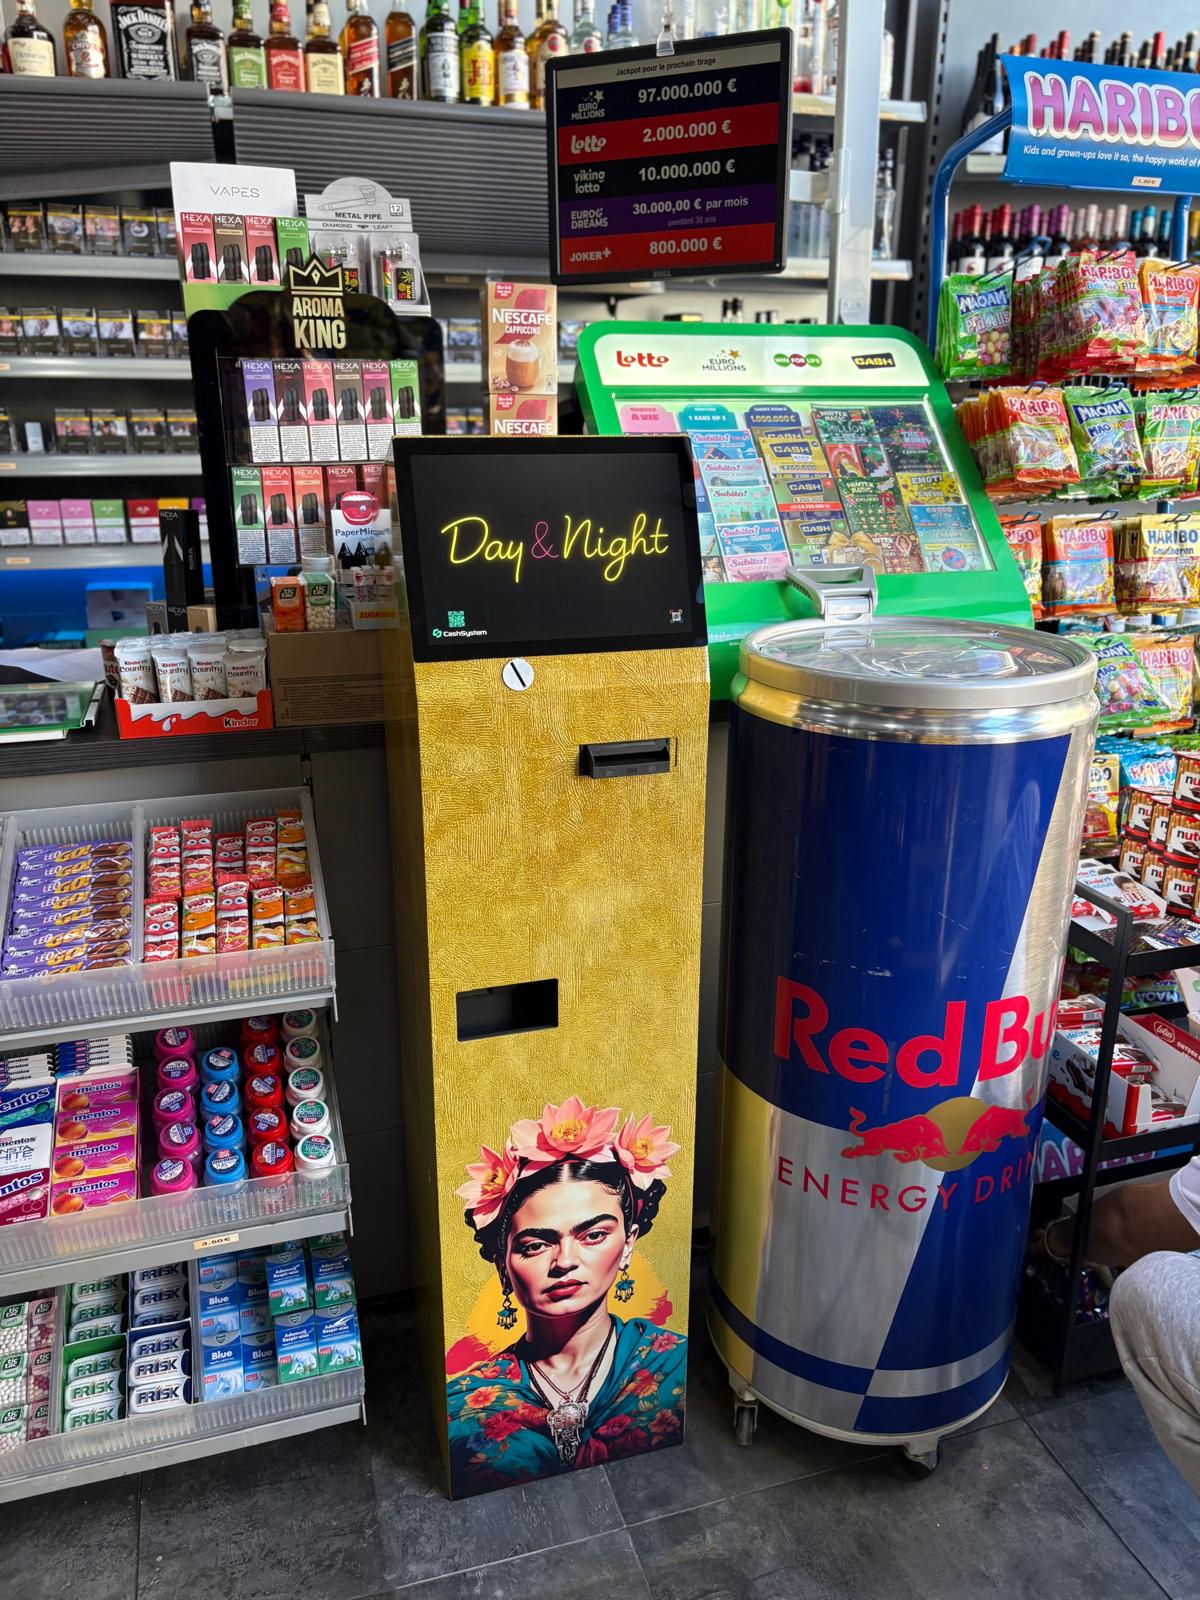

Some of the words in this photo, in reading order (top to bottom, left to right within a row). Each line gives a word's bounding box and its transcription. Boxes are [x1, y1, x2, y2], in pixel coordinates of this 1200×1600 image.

[615, 66, 642, 77] Jackpot
[642, 65, 658, 75] pour
[658, 63, 666, 71] le
[666, 60, 696, 72] prochain
[696, 57, 716, 68] tirage
[638, 80, 722, 104] 97.000.000
[727, 78, 737, 93] €
[578, 102, 598, 111] EURO
[571, 109, 605, 121] MILLIONS
[642, 121, 717, 143] 2.000.000
[721, 120, 732, 134] €
[1023, 145, 1040, 155] Kids
[1041, 146, 1056, 156] and
[1057, 148, 1096, 160] grown-ups
[1097, 150, 1113, 160] love
[1113, 151, 1119, 161] it
[1120, 154, 1130, 163] so,
[1132, 153, 1144, 163] the
[1145, 154, 1167, 166] happy
[1168, 156, 1188, 166] world
[1188, 158, 1196, 167] of
[573, 169, 606, 183] viking
[638, 160, 721, 182] 10.000.000
[725, 159, 736, 173] €
[209, 185, 260, 199] VAPES
[575, 182, 600, 195] lotto
[391, 205, 402, 213] 12
[632, 199, 691, 215] 30.000,00
[694, 198, 702, 209] €
[705, 200, 722, 211] par
[724, 196, 749, 207] mois
[182, 213, 211, 222] HEXA
[215, 215, 242, 224] HEXA
[335, 211, 362, 220] METAL
[571, 209, 596, 220] EURO
[278, 218, 305, 227] HEXA
[571, 217, 608, 230] DREAMS
[649, 238, 708, 256] 800.000
[712, 236, 722, 250] €
[1080, 266, 1131, 280] HARIBO
[1149, 272, 1195, 291] HARIBO
[293, 297, 344, 317] AROMA
[293, 319, 346, 349] KING
[505, 324, 541, 335] CAPPUCCINO
[244, 362, 270, 370] HEXA
[701, 361, 747, 372] MILLIONS
[708, 357, 735, 366] EURO
[854, 356, 893, 367] CASH
[1008, 398, 1061, 415] HARIBO
[1079, 401, 1131, 421] MAOAM
[693, 434, 730, 443] Subito!
[773, 445, 810, 454] CASH
[704, 462, 741, 471] Subito!
[713, 488, 747, 498] Subito!
[788, 483, 821, 491] CASH
[721, 526, 759, 537] Subito!
[801, 525, 831, 533] CASH
[1059, 527, 1108, 545] HARIBO
[1147, 529, 1199, 544] HARIBO
[441, 516, 524, 583] Day
[531, 520, 559, 559] &
[564, 513, 669, 582] Night
[729, 557, 767, 567] Subito!
[443, 629, 488, 639] CashSystem
[1140, 648, 1192, 666] HARIBO
[44, 865, 62, 876] LEO
[43, 882, 61, 893] LEO
[41, 896, 59, 908] LEO
[43, 913, 61, 924] LEO
[34, 952, 54, 963] LEO
[774, 974, 967, 1088] Red
[76, 1080, 121, 1094] mentos
[0, 1088, 50, 1112] entos
[72, 1108, 120, 1122] mentos
[0, 1145, 34, 1155] NSTA
[69, 1142, 119, 1157] mentos
[0, 1172, 44, 1196] ntos
[68, 1178, 119, 1194] mentos
[777, 1155, 958, 1213] ENERGY
[201, 1236, 231, 1247] 3.50€
[141, 1288, 180, 1305] FRISK
[247, 1287, 268, 1297] Blue
[209, 1295, 229, 1306] Blue
[139, 1338, 179, 1356] FRISK
[252, 1348, 273, 1359] Blue
[7, 1356, 18, 1364] tic
[211, 1350, 233, 1361] Blue
[76, 1357, 116, 1374] FRISK
[136, 1358, 178, 1377] FRISK
[73, 1380, 114, 1399] FRISK
[138, 1384, 180, 1404] FRISK
[2, 1415, 17, 1423] tac
[71, 1407, 114, 1427] FRISK
